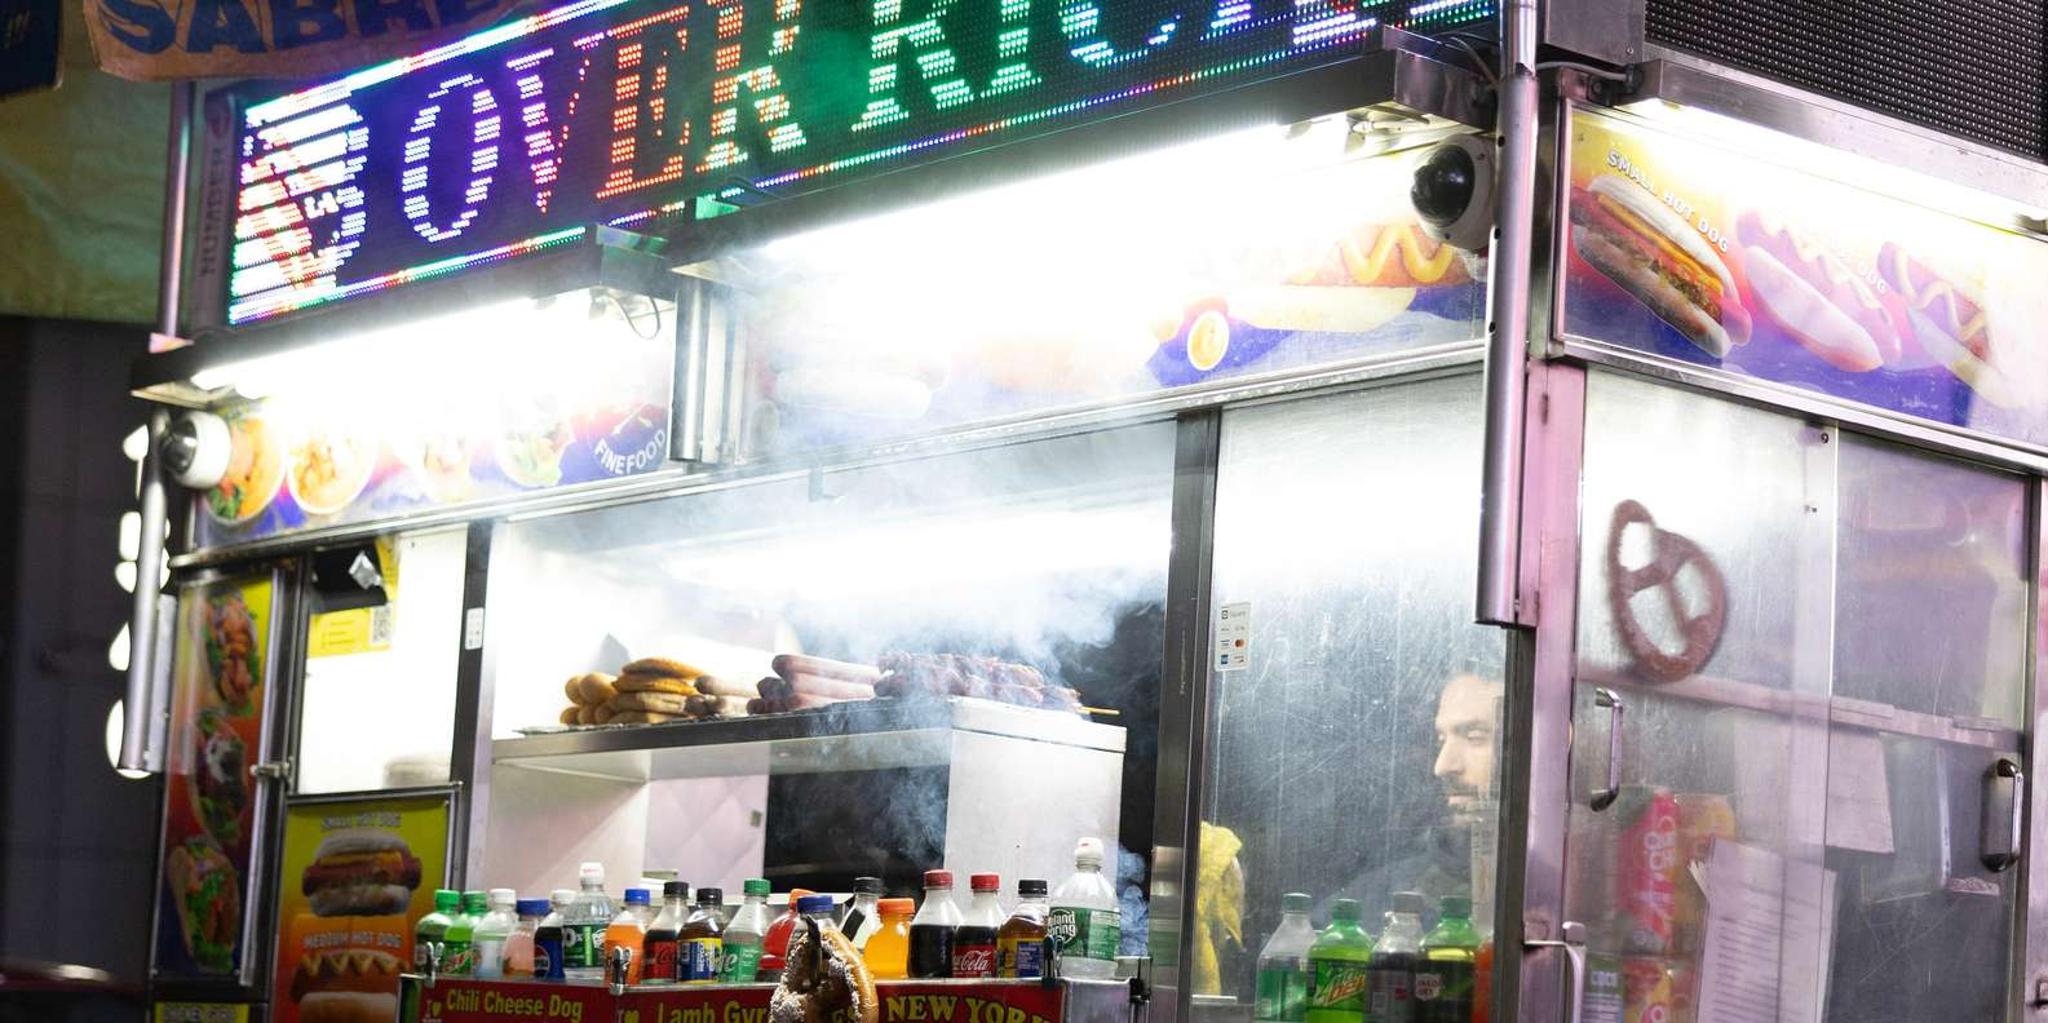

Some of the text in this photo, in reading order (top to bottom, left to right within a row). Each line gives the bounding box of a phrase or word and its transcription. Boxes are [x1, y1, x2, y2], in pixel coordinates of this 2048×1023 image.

[402, 0, 807, 243] OVER
[851, 0, 1299, 132] RI
[1606, 148, 1658, 197] SMALL
[1697, 217, 1729, 254] DOG
[1048, 910, 1076, 925] land
[447, 989, 583, 1023] Chili Cheese Dog
[656, 1000, 769, 1023] Lamb Gyr
[886, 995, 958, 1022] NEW
